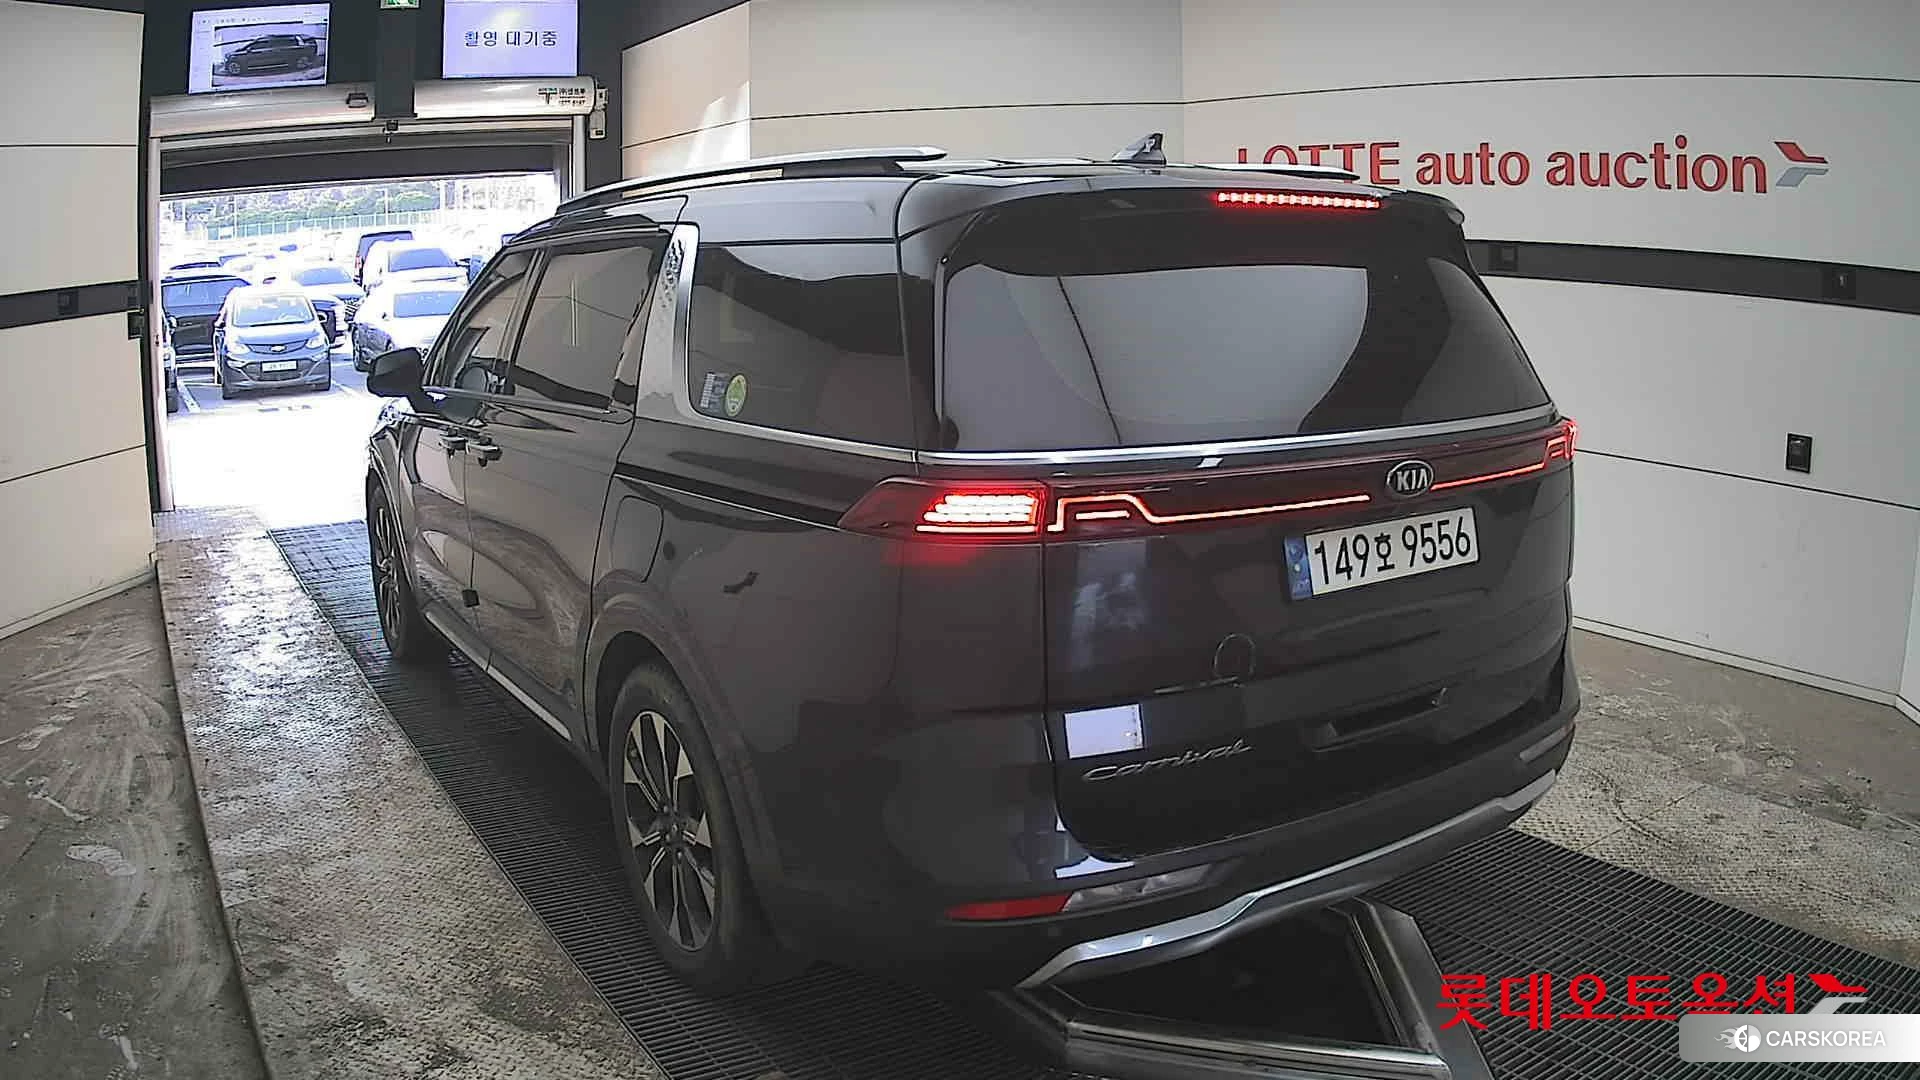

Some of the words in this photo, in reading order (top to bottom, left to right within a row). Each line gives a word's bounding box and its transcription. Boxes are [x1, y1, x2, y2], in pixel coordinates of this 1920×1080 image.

[506, 31, 557, 47] 대기중
[1416, 142, 1530, 187] auto
[1547, 134, 1767, 194] auction
[1397, 468, 1428, 491] KIA
[1402, 516, 1471, 568] 9556
[1082, 738, 1252, 782] Carnival
